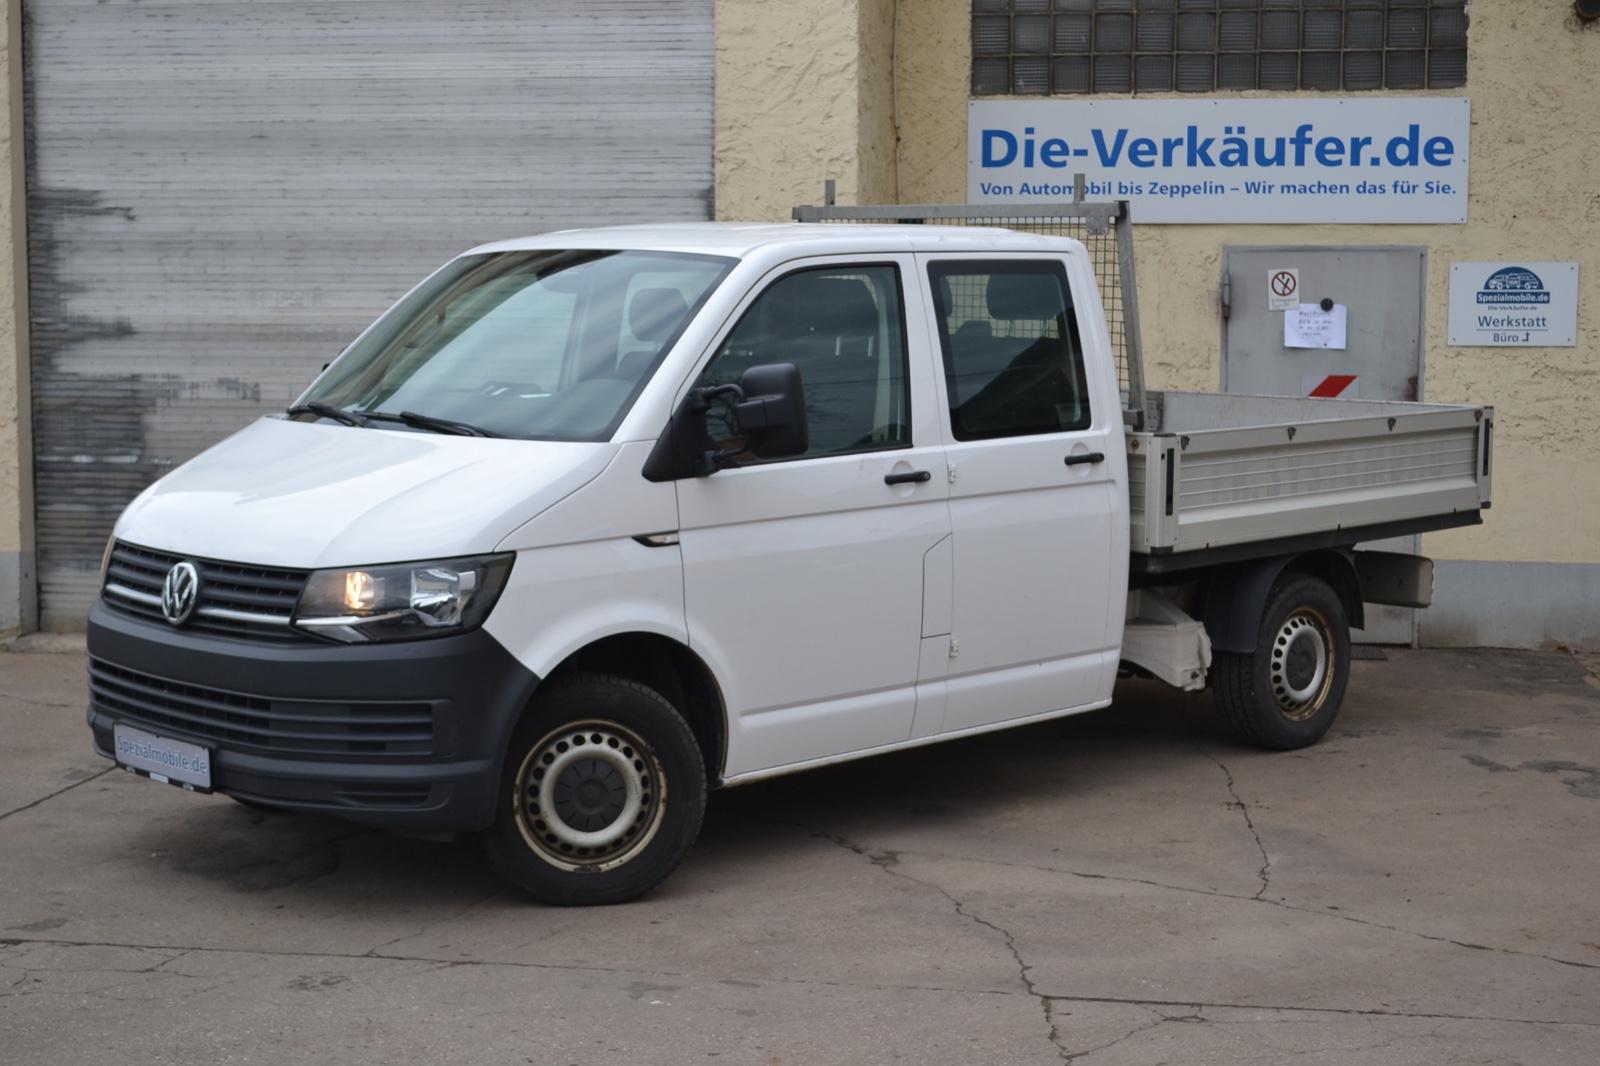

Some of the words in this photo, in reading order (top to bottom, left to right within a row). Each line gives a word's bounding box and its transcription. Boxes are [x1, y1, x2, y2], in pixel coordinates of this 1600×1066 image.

[981, 124, 1455, 168] Die-Verkäufer.de
[980, 182, 1013, 196] Von
[1118, 181, 1143, 196] bis
[1148, 181, 1225, 198] Zeppelin
[1244, 180, 1275, 195] Wir
[1280, 180, 1350, 195] machen
[1355, 180, 1386, 195] das
[1392, 179, 1419, 195] für
[1425, 180, 1457, 195] Sie.
[1478, 292, 1548, 303] Spezialmobile.de
[1477, 315, 1547, 327] Werkstatt
[1493, 332, 1519, 342] Büro
[117, 735, 208, 774] Spezialmobile.de
